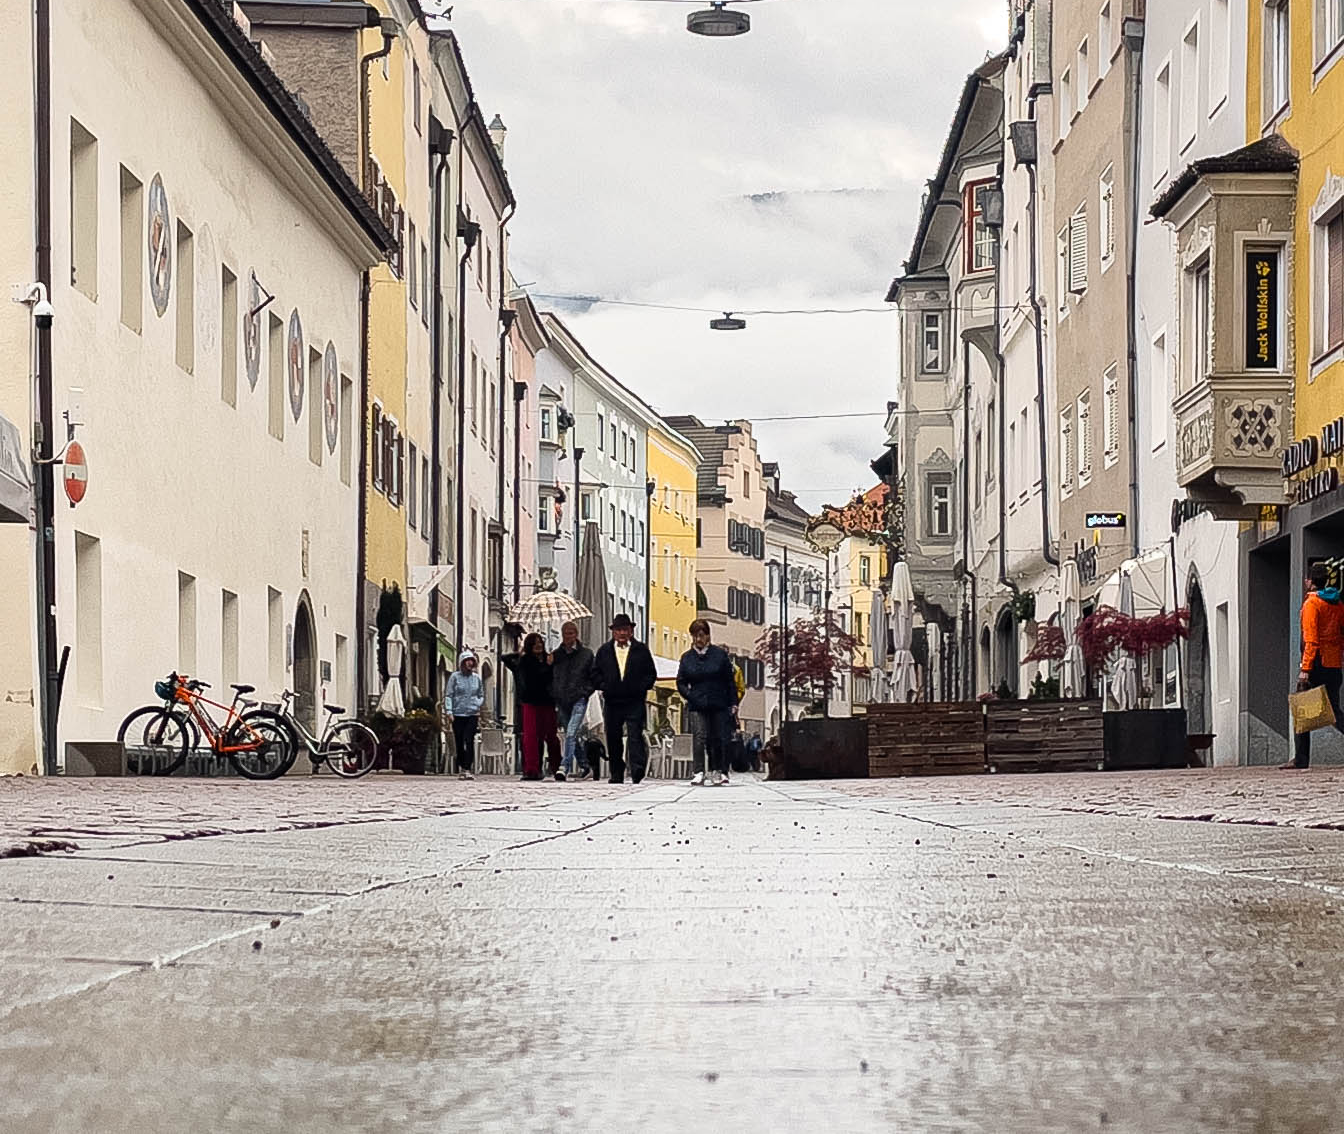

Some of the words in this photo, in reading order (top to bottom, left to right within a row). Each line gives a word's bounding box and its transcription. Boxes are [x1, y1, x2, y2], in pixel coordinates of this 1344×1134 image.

[1257, 278, 1268, 331] Wolfskin
[1257, 333, 1268, 362] Jack
[1087, 514, 1119, 526] globus
